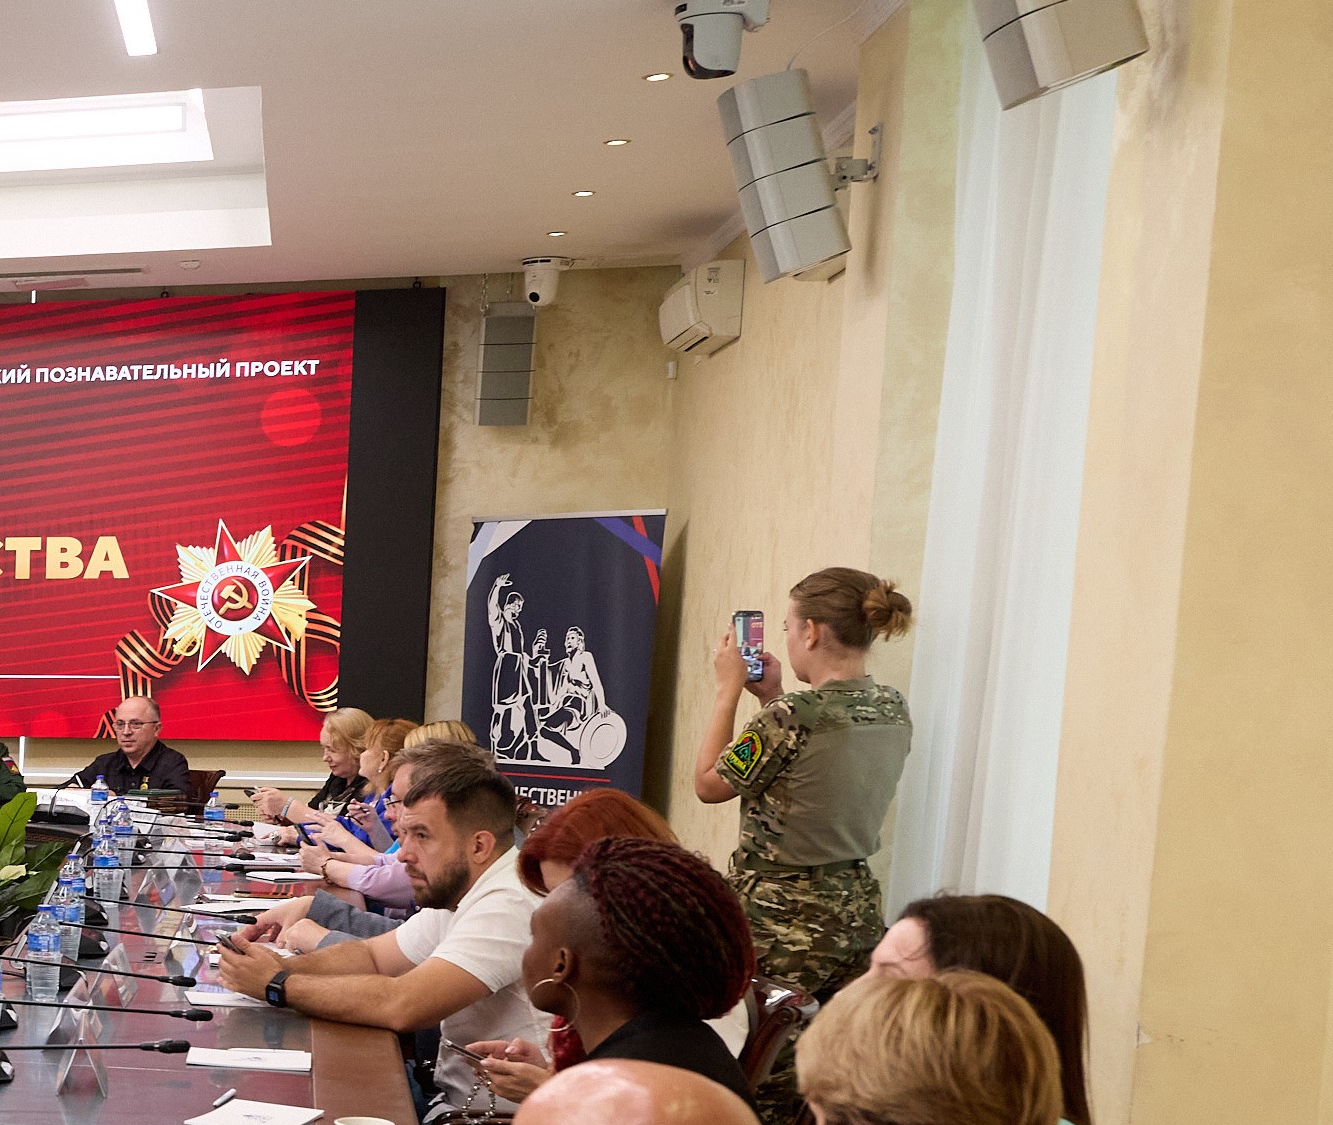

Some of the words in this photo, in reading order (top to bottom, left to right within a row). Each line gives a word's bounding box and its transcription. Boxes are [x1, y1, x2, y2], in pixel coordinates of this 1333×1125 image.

[35, 358, 231, 384] ПОЗНАВАТЕЛЬНЫЙ
[234, 359, 320, 378] ПРОЕКТ
[199, 564, 259, 629] ОТЕЧЕСТВЕННАЯ
[253, 580, 271, 622] ВОЙНА
[514, 786, 583, 806] ЕСТВЕН
